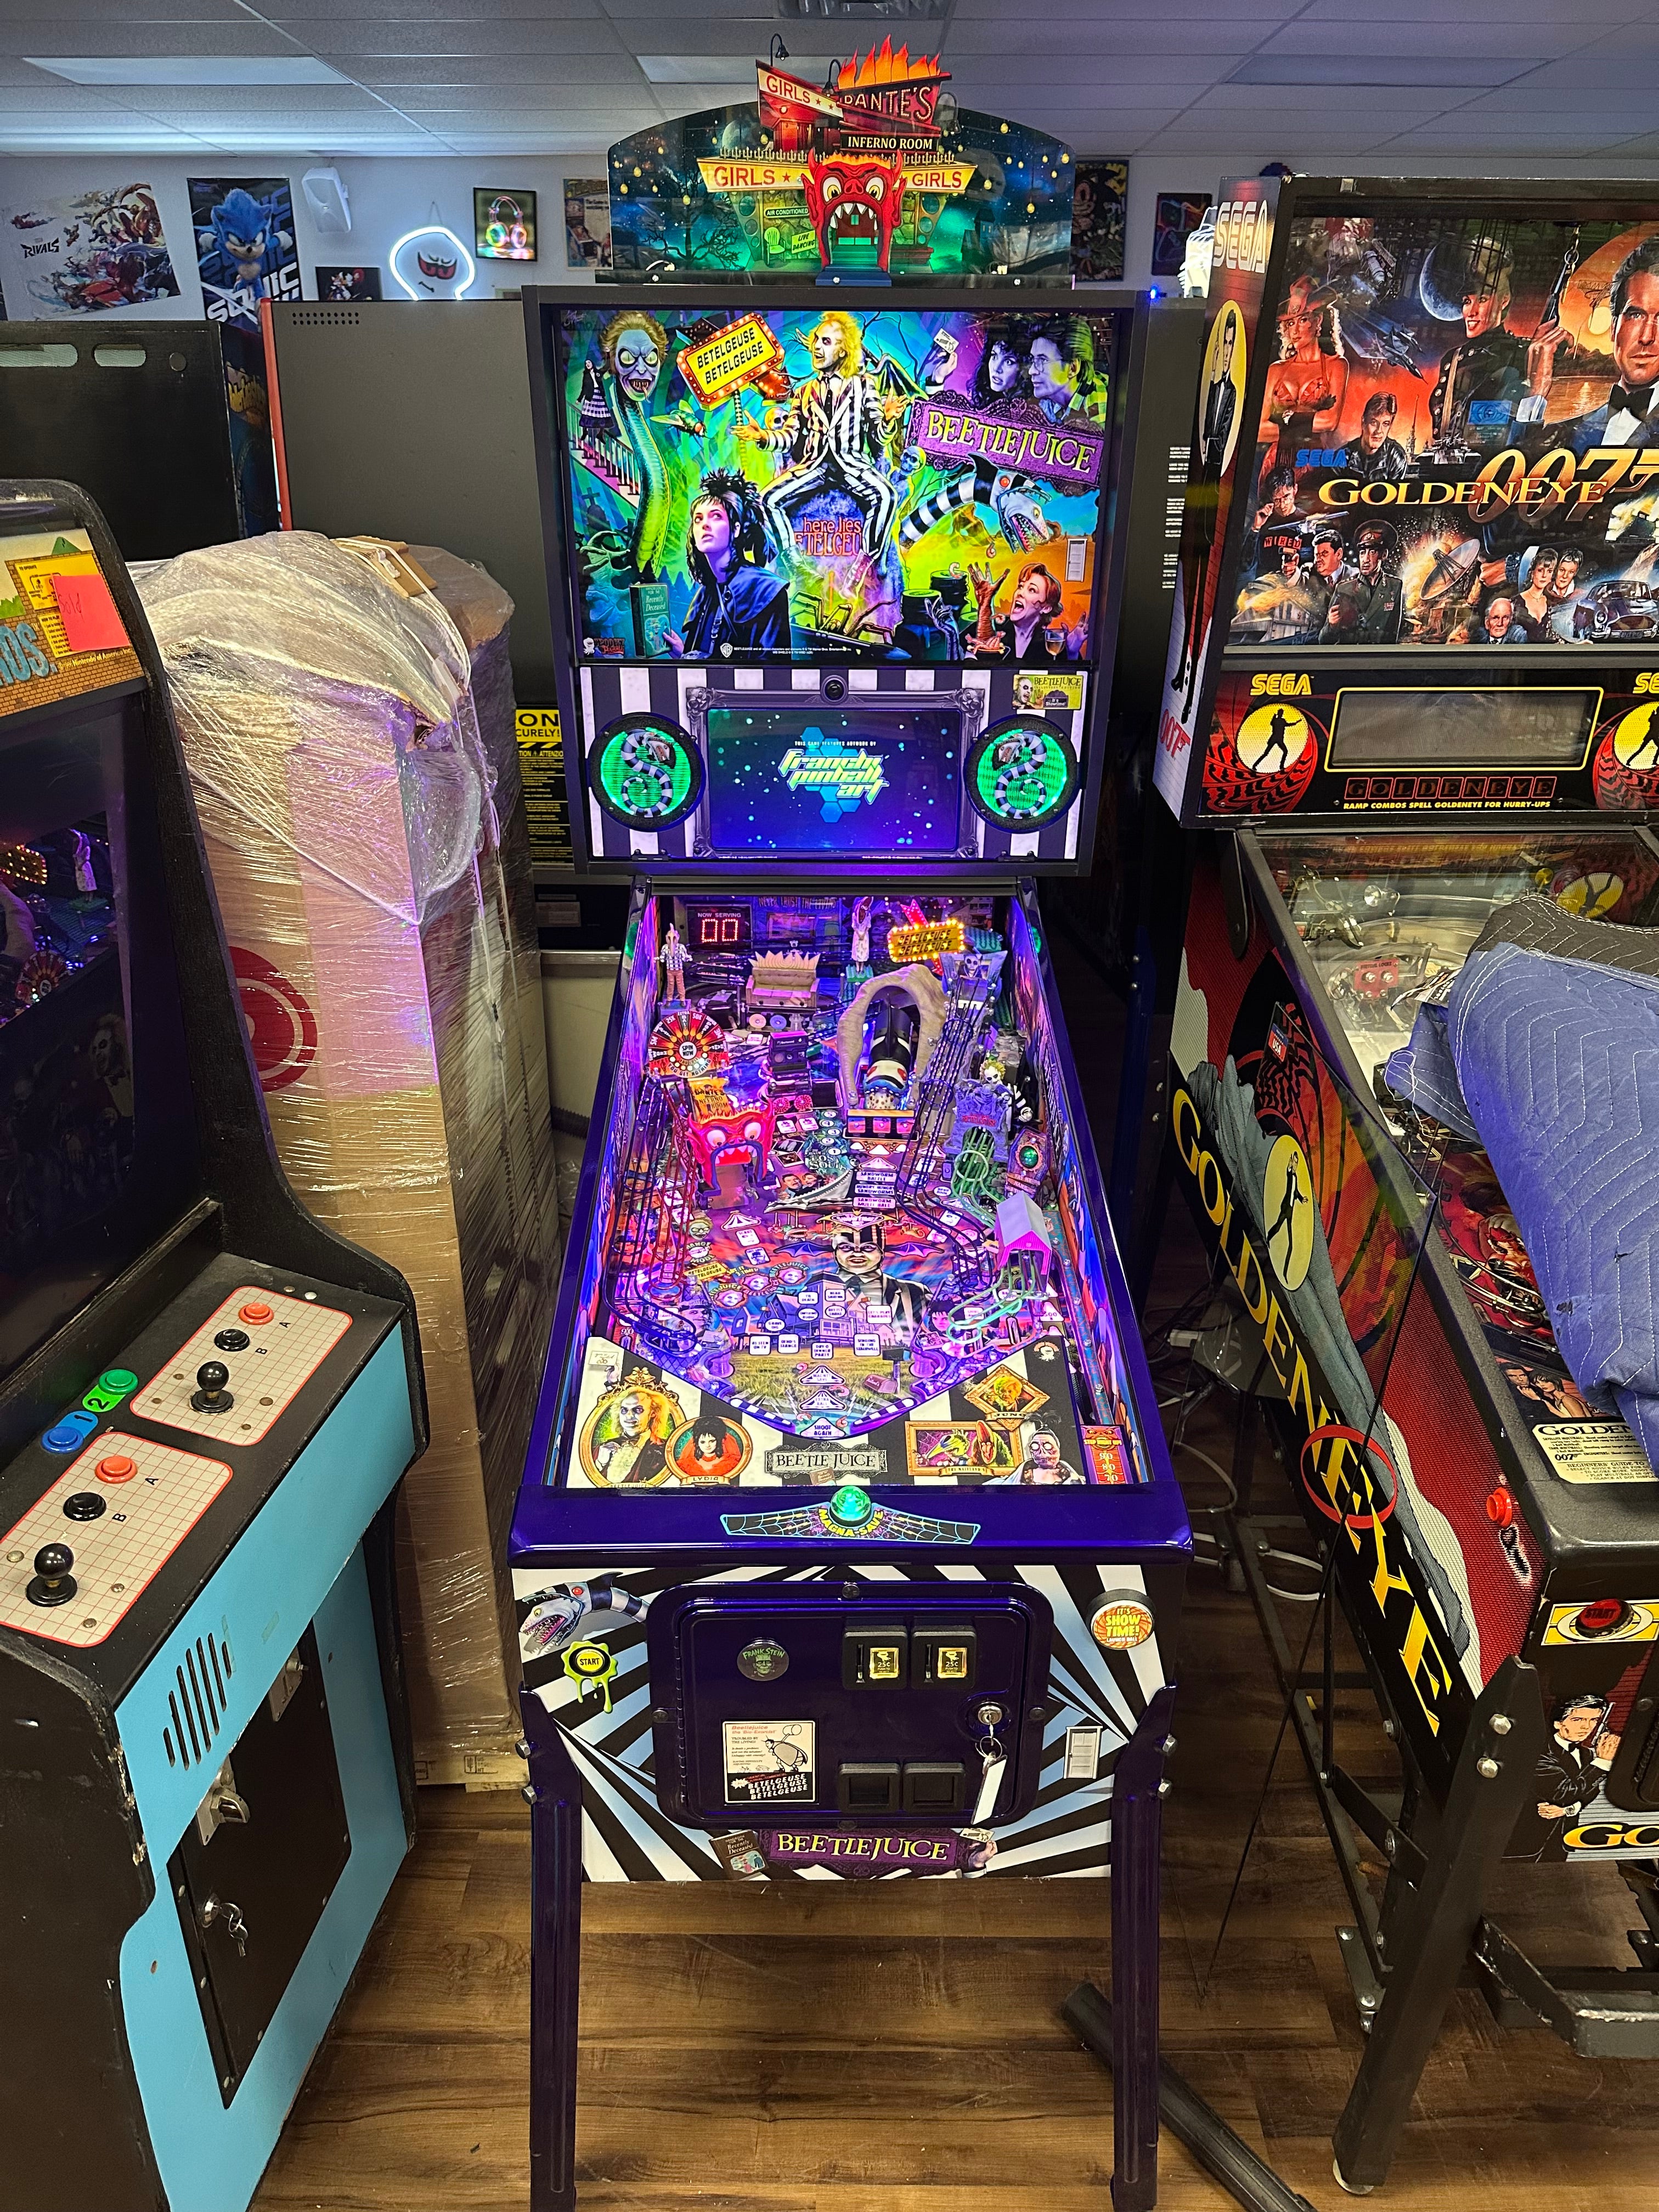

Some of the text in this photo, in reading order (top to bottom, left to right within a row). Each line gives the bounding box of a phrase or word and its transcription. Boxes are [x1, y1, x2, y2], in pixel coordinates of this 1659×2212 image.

[766, 75, 811, 104] GIRLS
[843, 86, 932, 122] DANTE'S
[848, 136, 933, 150] INFERNO ROOM
[714, 166, 775, 187] GIRLS
[912, 171, 962, 188] GIRLS
[792, 239, 815, 251] DANCING
[798, 233, 809, 242] LIVE
[1212, 200, 1267, 274] SEGA
[20, 237, 59, 258] RIVALS
[697, 327, 755, 369] BETELGEUSE
[704, 341, 764, 385] BETELGEUSE
[927, 410, 1096, 473] BEETLEJUICE
[1295, 449, 1348, 467] SEGA
[1318, 477, 1607, 506] GOLDENEYE
[804, 516, 861, 533] here lies
[1263, 536, 1301, 549] WIRED
[72, 656, 96, 667] Nintendo
[103, 650, 123, 659] America
[1034, 676, 1081, 687] BEETLEJUICE
[1250, 673, 1312, 696] SEGA
[1160, 709, 1191, 758] 007
[702, 918, 738, 943] 00
[1273, 1038, 1282, 1056] USA
[697, 1268, 722, 1278] TELGEUSE
[770, 1261, 810, 1277] BEETLEJUICE
[279, 1320, 291, 1328] A
[256, 1346, 268, 1355] B
[87, 1397, 111, 1410] 2
[74, 1414, 93, 1423] 1
[1173, 1088, 1453, 1737] GOLDENEYE
[776, 1453, 876, 1470] BEETLE JUICE
[144, 1476, 159, 1486] A
[1104, 1474, 1118, 1482] 70
[112, 1513, 127, 1523] B
[817, 1507, 884, 1537] MAGNA-SAVE
[1105, 1615, 1141, 1626] SHOW
[1584, 1607, 1617, 1621] START
[1106, 1626, 1139, 1637] TIME!
[742, 1647, 785, 1660] FRANK STEIN
[579, 1657, 600, 1667] START
[748, 1773, 805, 1789] BETELGEUSE
[749, 1779, 807, 1795] BETELGEUSE
[751, 1784, 808, 1800] BETELGEUSE
[1564, 1822, 1659, 1851] GO
[727, 1840, 750, 1850] Recently
[728, 1844, 753, 1854] Deceased
[777, 1833, 950, 1861] BEETLEJUICE
